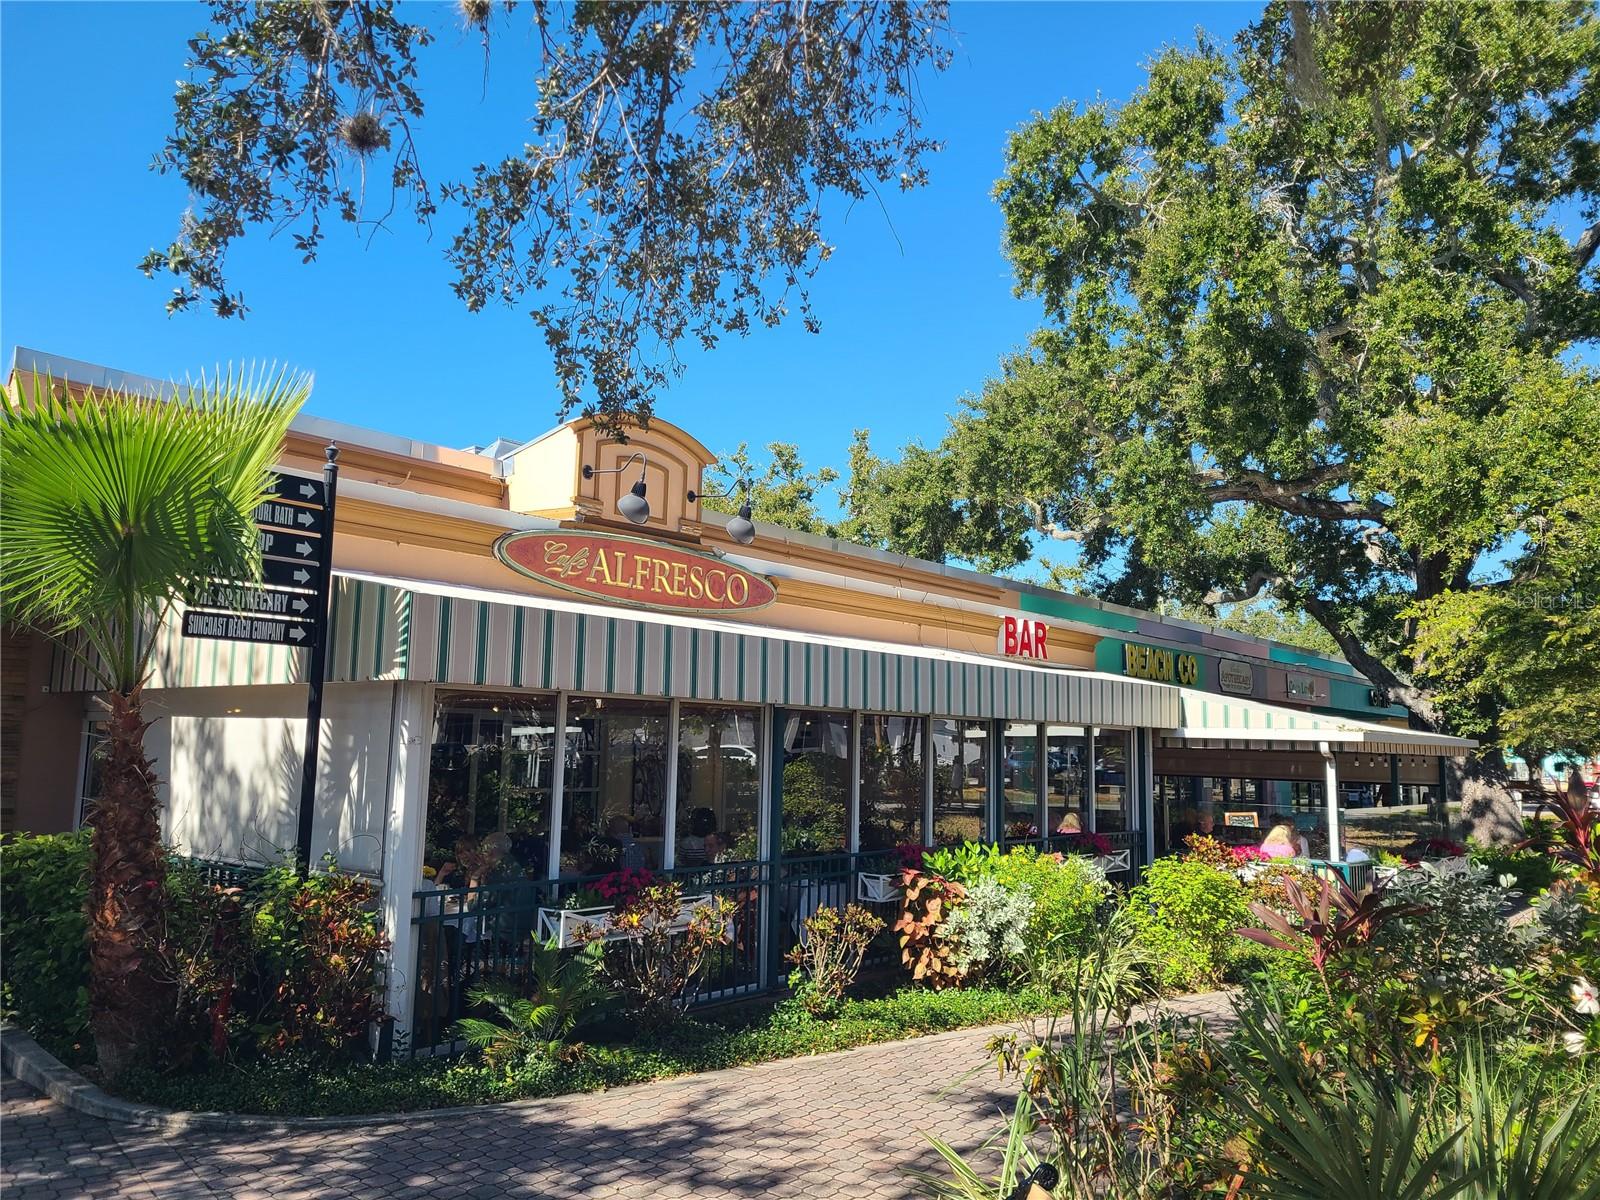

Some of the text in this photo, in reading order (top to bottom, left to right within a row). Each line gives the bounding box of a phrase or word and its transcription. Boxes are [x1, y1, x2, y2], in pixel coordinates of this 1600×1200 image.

[274, 505, 294, 526] BATH
[586, 547, 750, 606] ALFRESCO
[187, 614, 286, 642] SUNCOAST BEACH COMPANY
[1004, 615, 1048, 660] BAR
[1124, 643, 1199, 685] BEACH CO
